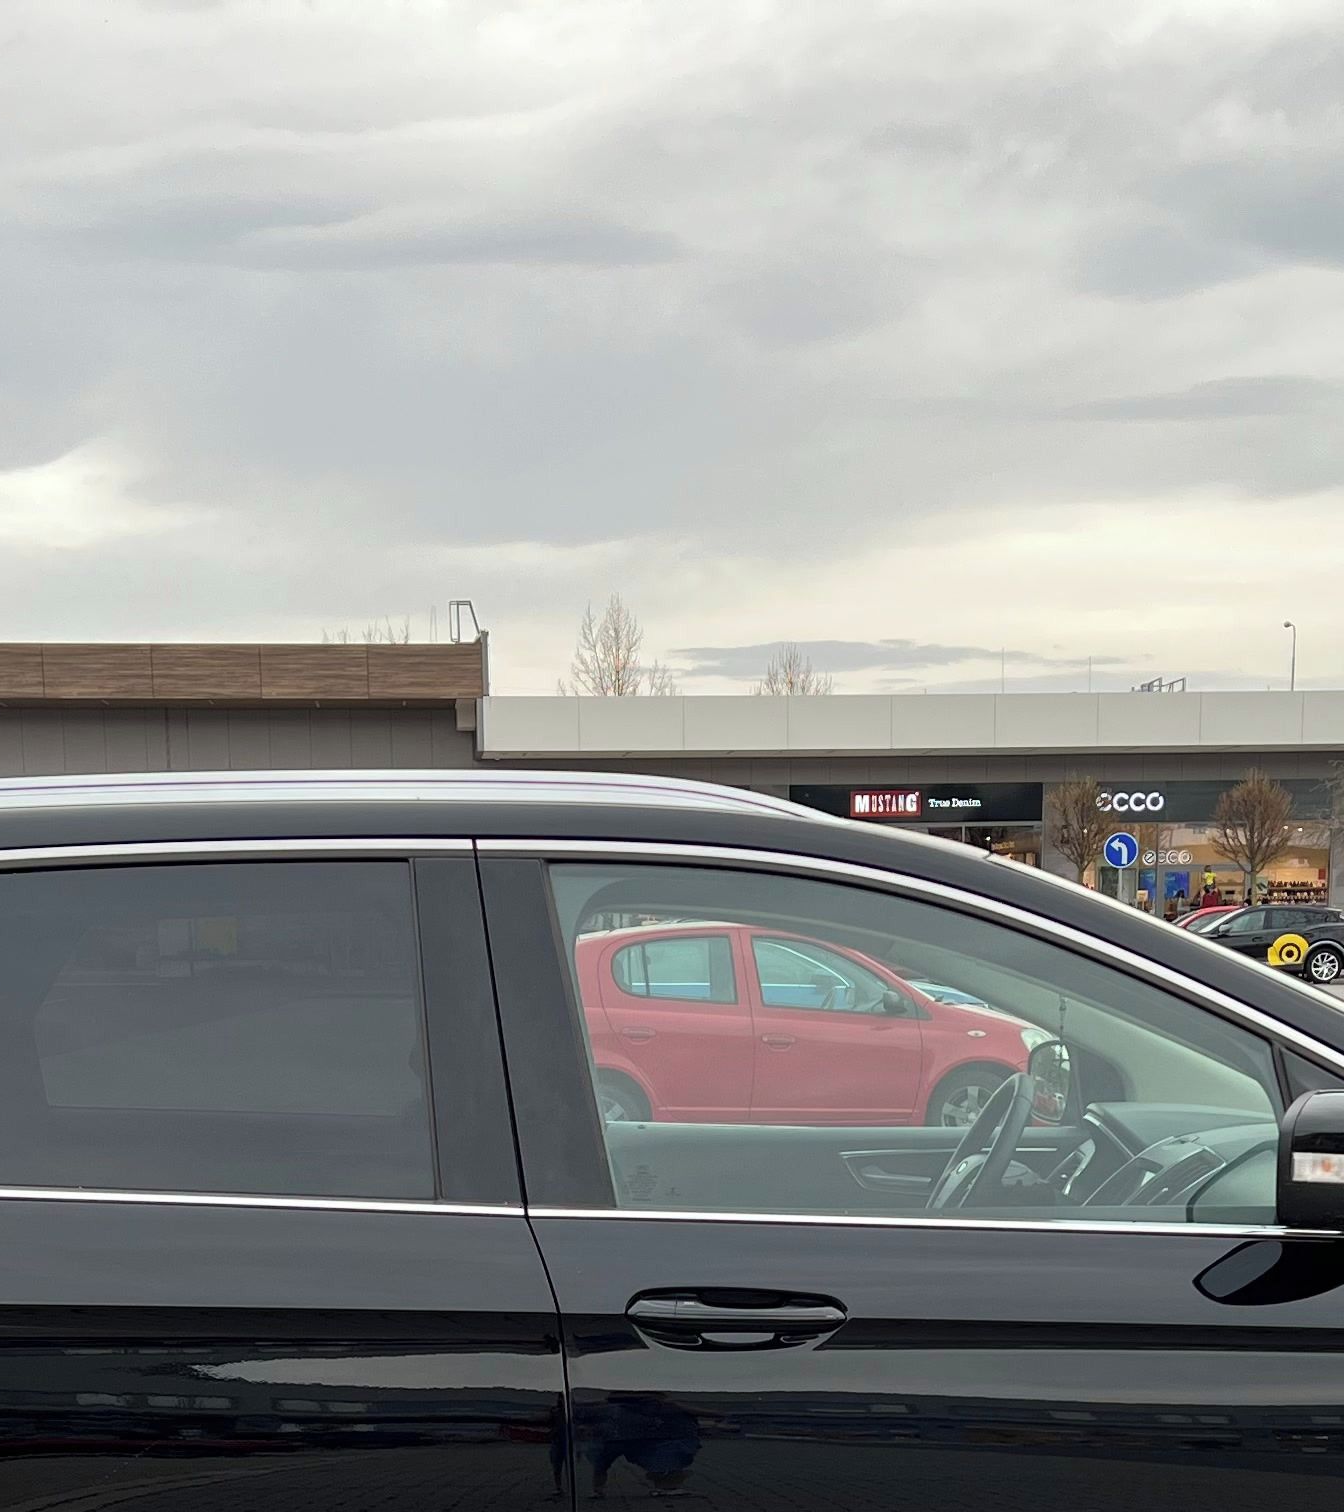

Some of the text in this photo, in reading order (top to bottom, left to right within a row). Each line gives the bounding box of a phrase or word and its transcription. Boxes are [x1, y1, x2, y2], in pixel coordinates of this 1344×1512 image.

[855, 794, 918, 813] MUSTANG
[928, 797, 981, 808] True Denim
[1096, 792, 1164, 812] ecco
